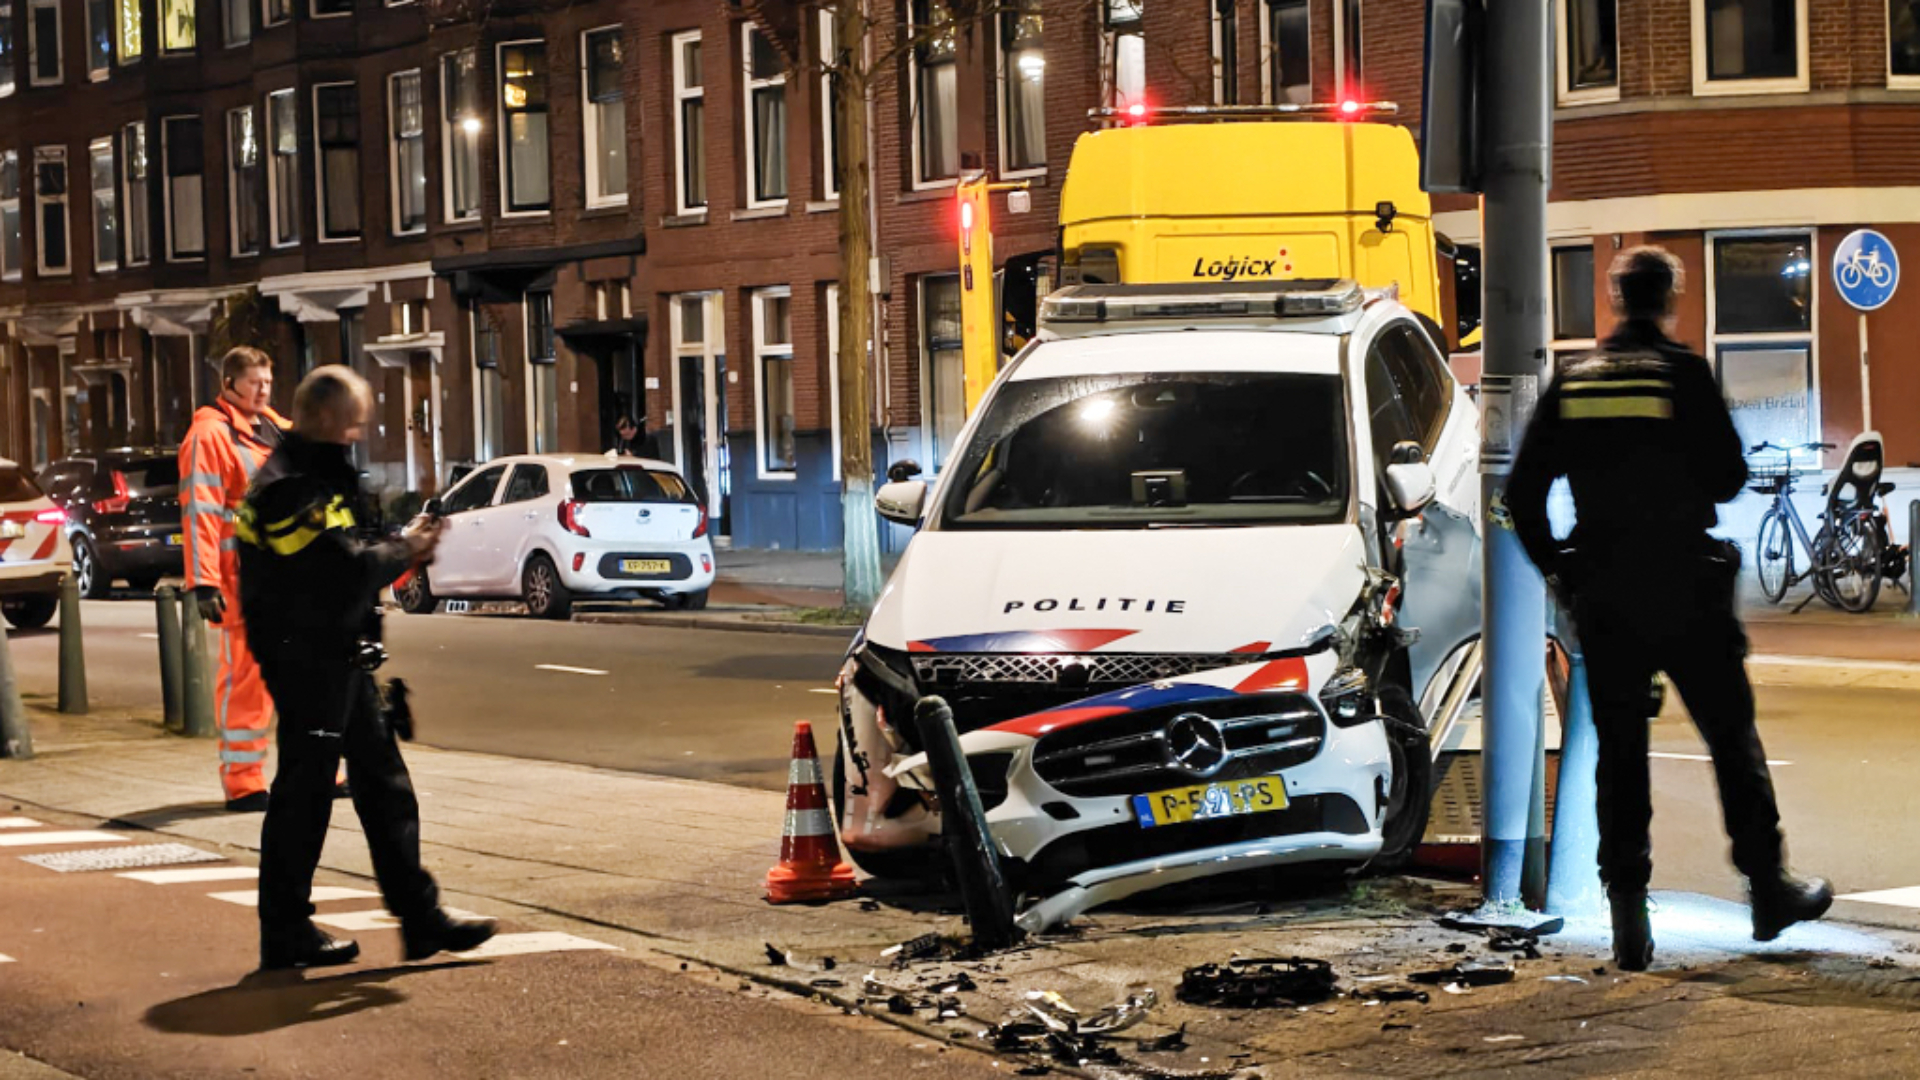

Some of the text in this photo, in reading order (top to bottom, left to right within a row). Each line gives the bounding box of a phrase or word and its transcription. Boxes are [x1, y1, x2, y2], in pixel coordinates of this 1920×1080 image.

[1193, 256, 1276, 280] Logicx
[1765, 396, 1805, 410] Bridal
[1003, 597, 1186, 614] POLITIE
[1161, 781, 1274, 819] P-591-PS
